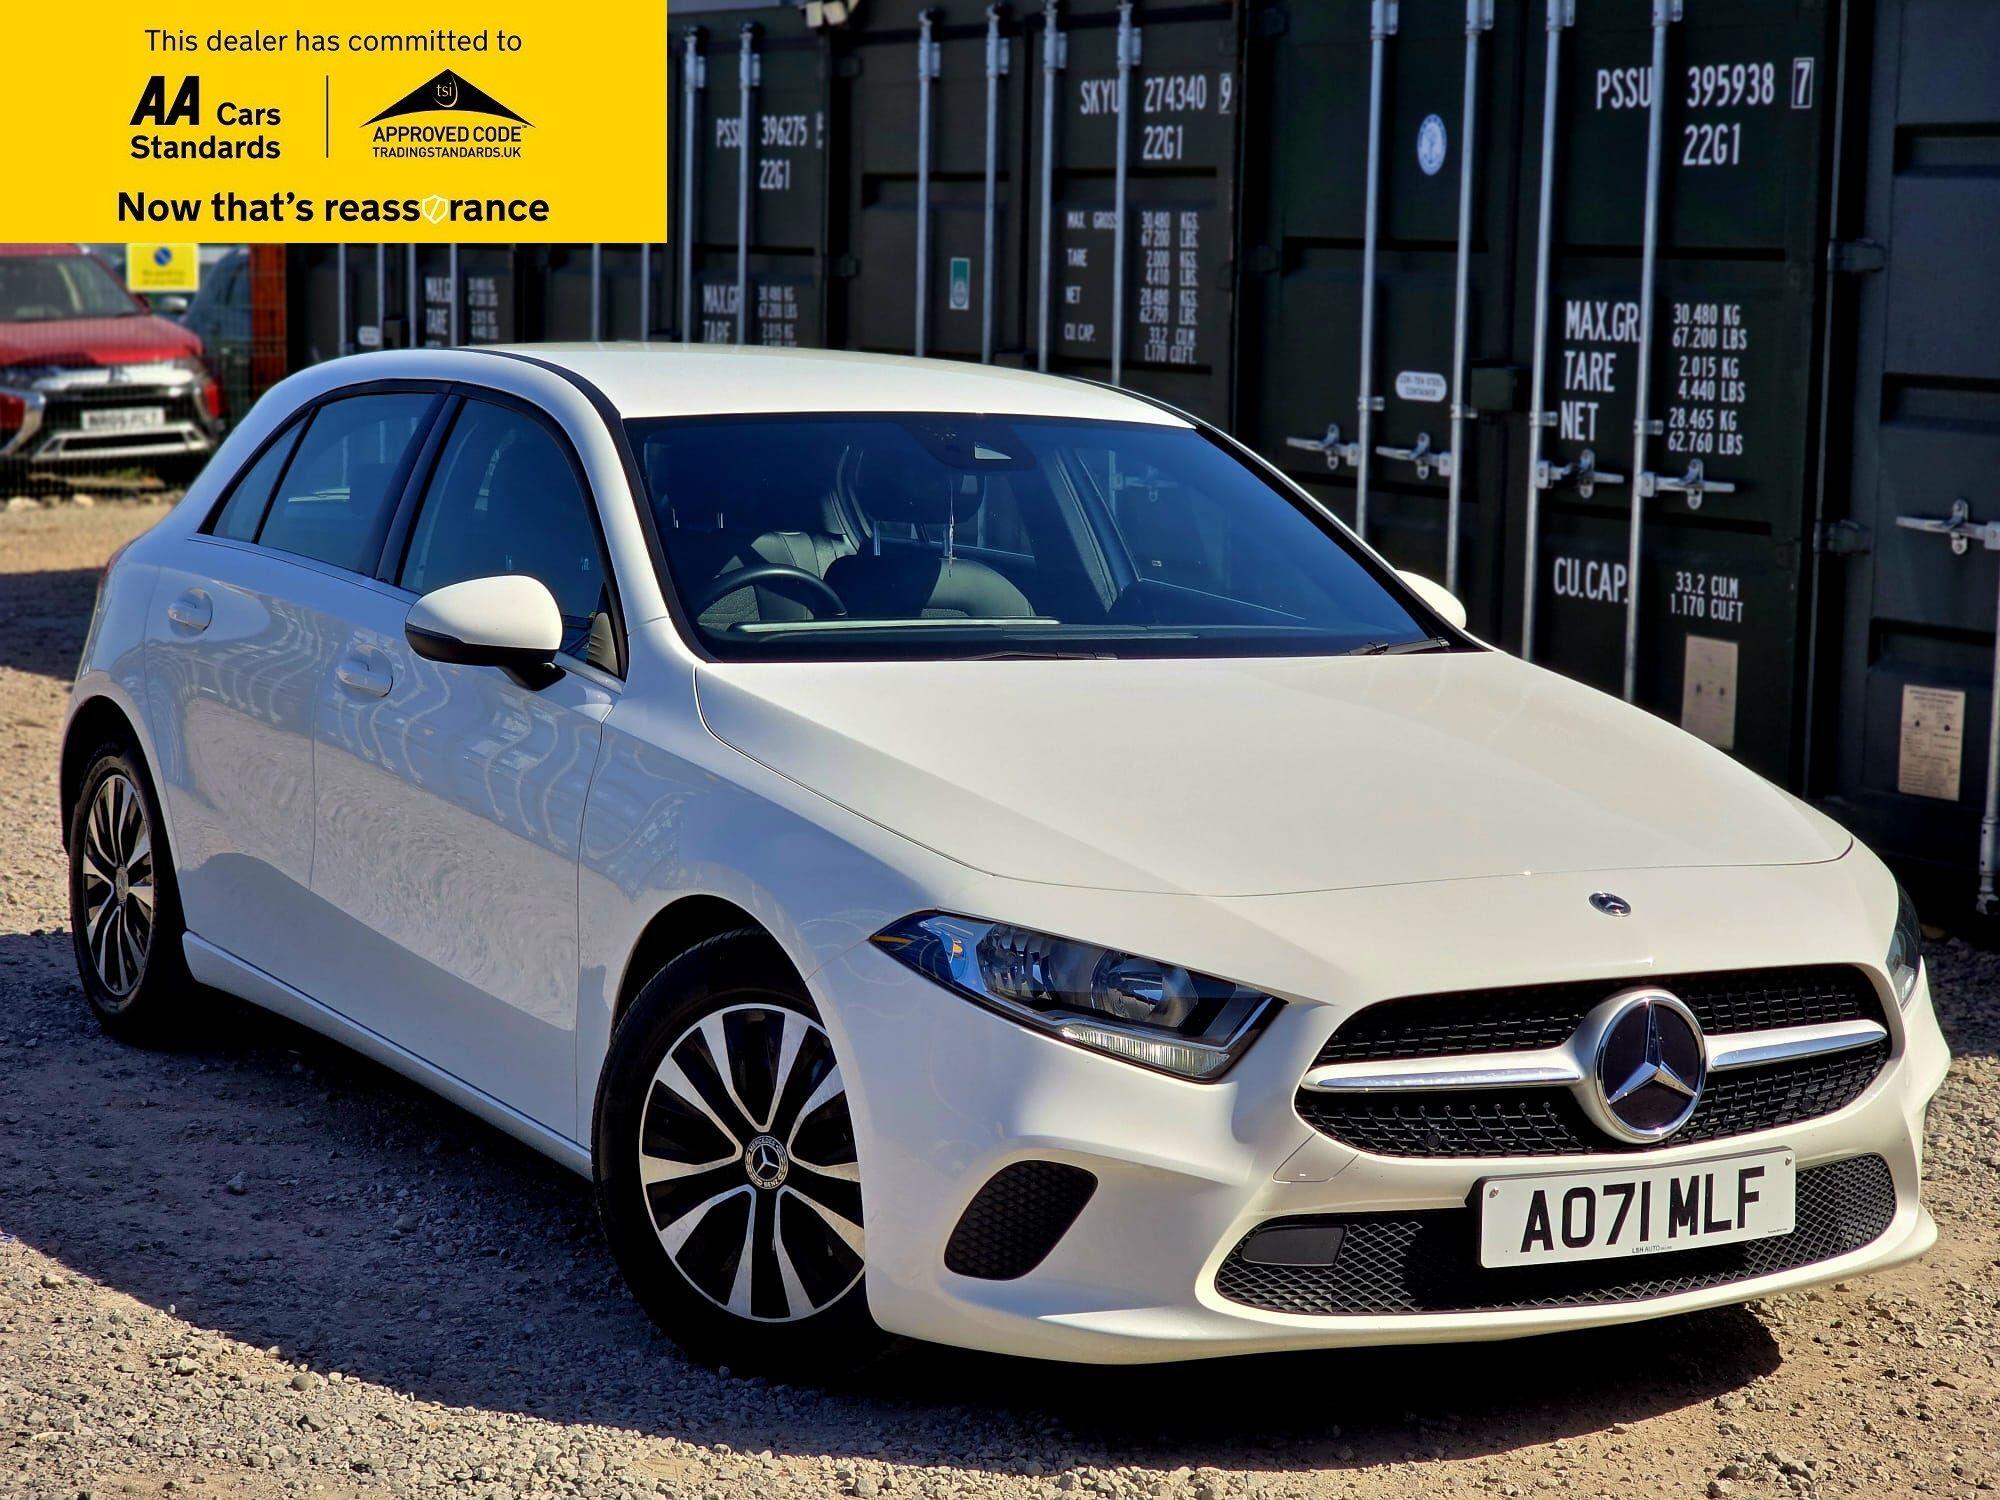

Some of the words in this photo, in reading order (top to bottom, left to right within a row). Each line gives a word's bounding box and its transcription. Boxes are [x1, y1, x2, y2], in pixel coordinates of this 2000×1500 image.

[1080, 80, 1120, 115] SKYU
[1145, 75, 1206, 112] 274340
[1220, 74, 1232, 112] 9
[1597, 68, 1652, 109] PSSU
[1688, 63, 1774, 107] 395938
[1793, 59, 1813, 108] 7
[762, 116, 807, 146] 396275
[1143, 126, 1182, 160] 22G1
[1683, 123, 1740, 165] 22G1
[760, 160, 790, 189] 22G1
[1674, 304, 1717, 324] 30.480
[1724, 305, 1740, 325] KG
[1673, 327, 1717, 348] 67.200
[1723, 328, 1747, 350] LBS
[1565, 351, 1616, 392] TARE
[1680, 356, 1716, 377] 2.015
[1722, 358, 1738, 379] KG
[1678, 379, 1715, 401] 4.440
[1721, 381, 1745, 402] LBS
[1561, 401, 1598, 441] NET
[1669, 407, 1713, 430] 28.465
[1720, 410, 1736, 431] KG
[1668, 431, 1713, 453] 62.760
[1719, 430, 1742, 455] LBS
[1553, 558, 1629, 603] CU.CAP.
[1675, 572, 1705, 595] 33.2
[1711, 576, 1738, 599] CU.M
[1670, 593, 1704, 617] 1.170
[1711, 599, 1743, 622] CU.FT
[1668, 1166, 1765, 1239] MLF
